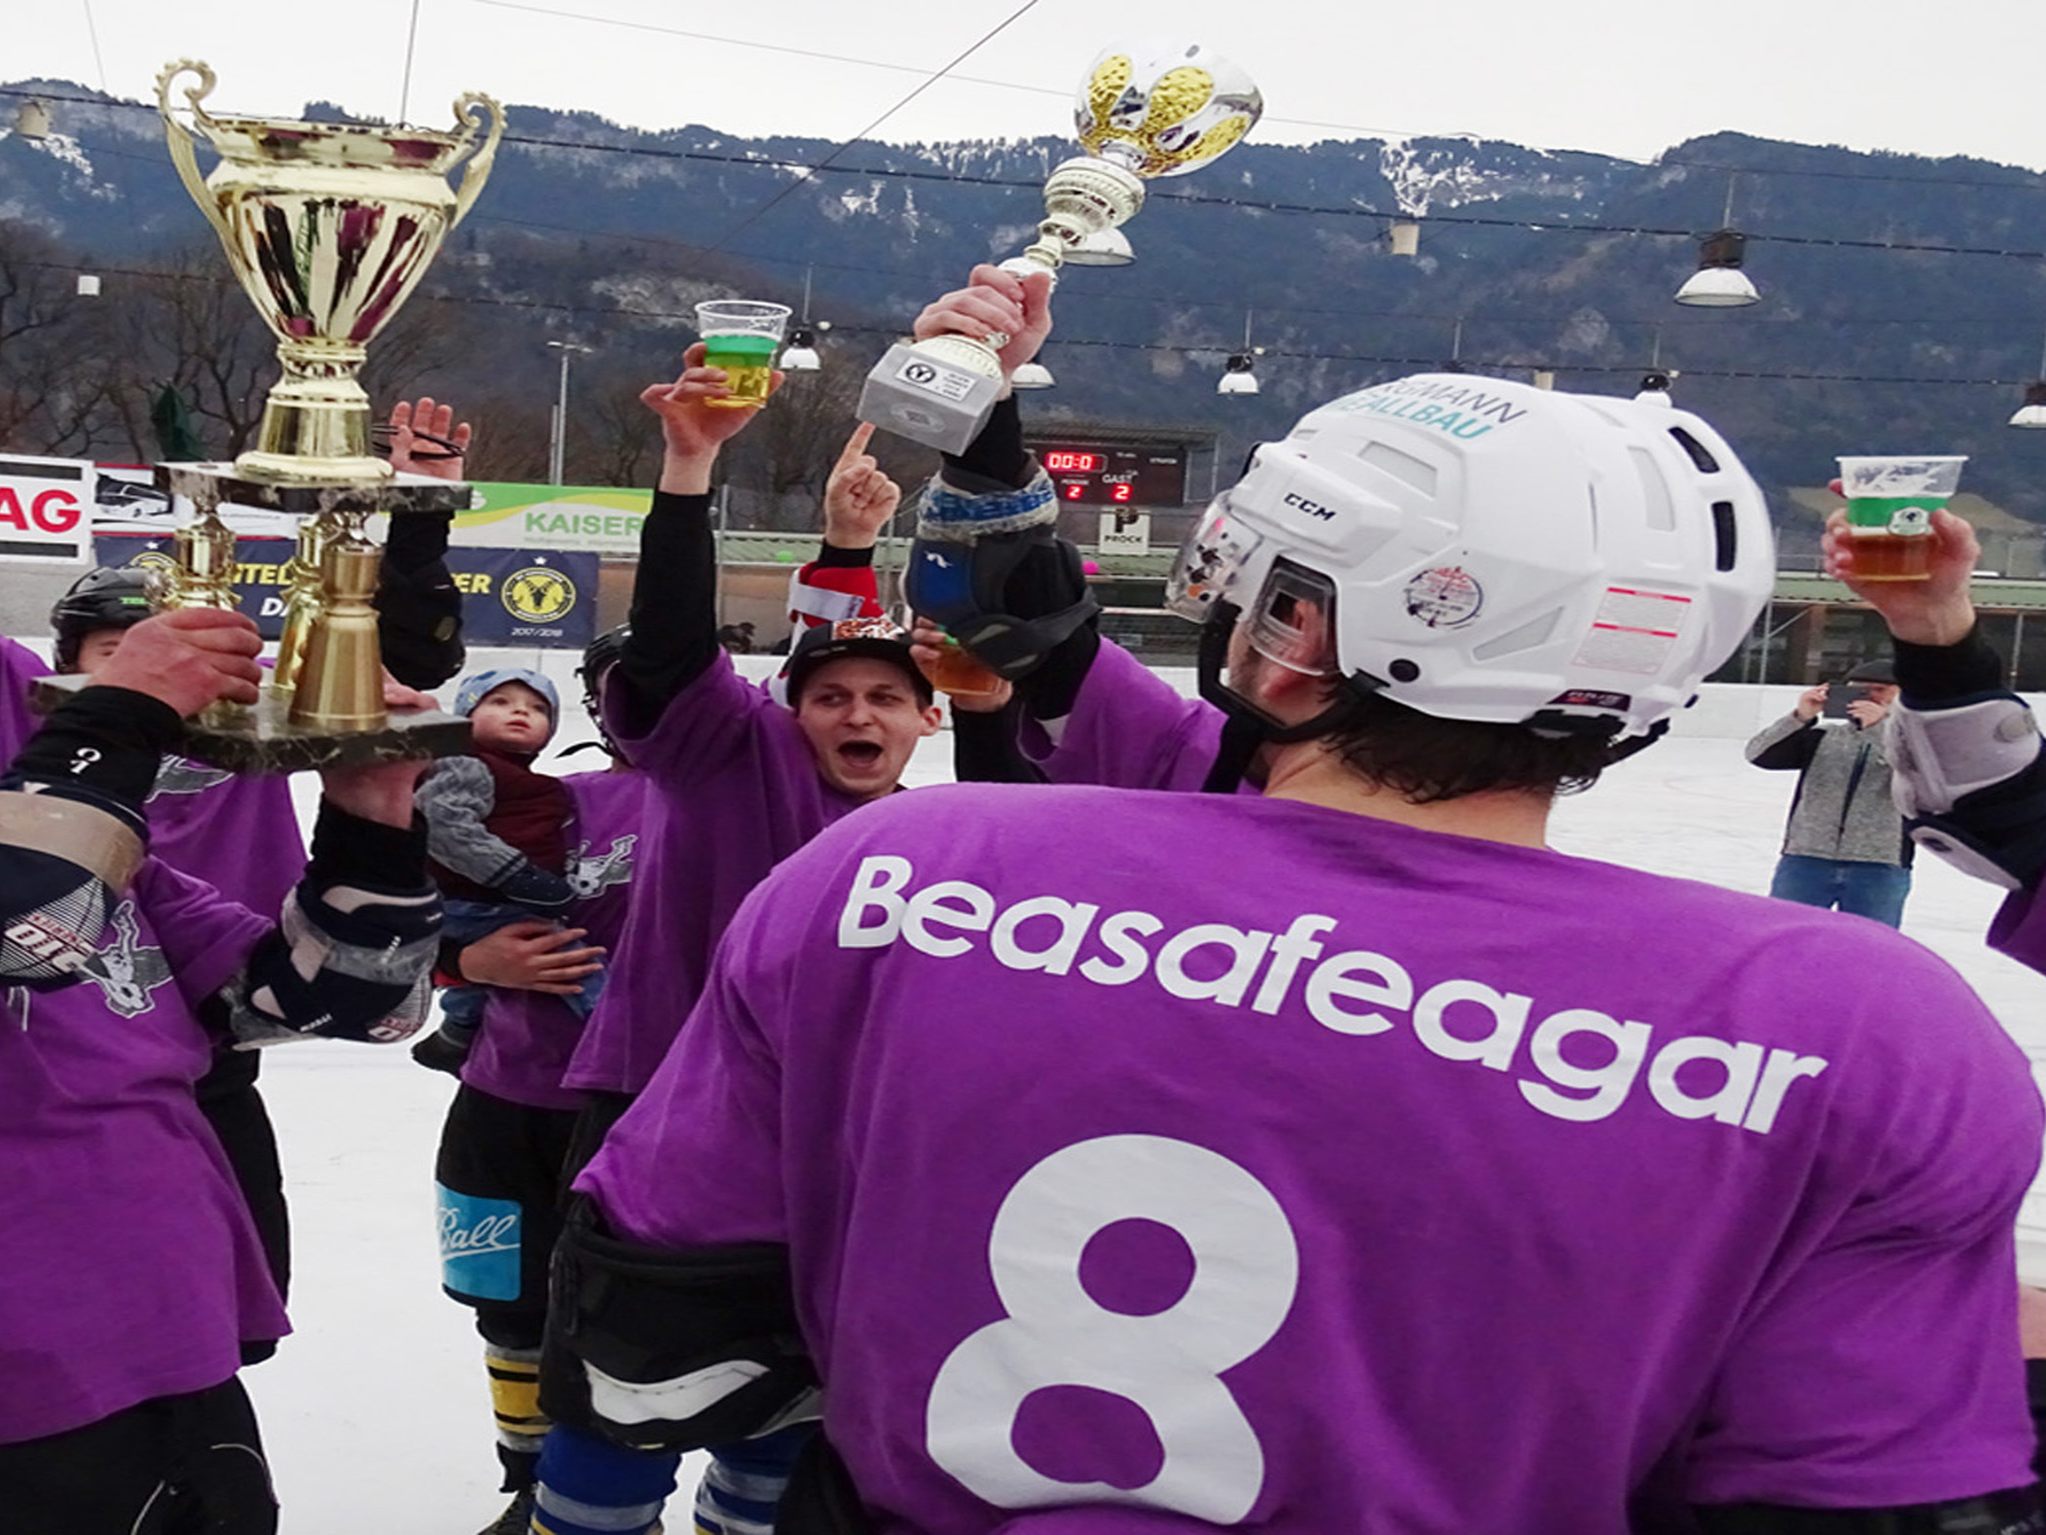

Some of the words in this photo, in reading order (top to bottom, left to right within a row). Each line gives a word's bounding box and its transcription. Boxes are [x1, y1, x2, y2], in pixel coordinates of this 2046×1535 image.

[1067, 486, 1081, 499] 2
[1114, 485, 1131, 500] 2
[1284, 492, 1336, 521] CCM
[525, 512, 643, 536] KAISER
[1104, 534, 1142, 543] PROCK
[452, 573, 492, 594] ER
[838, 855, 1828, 1134] Beasafeagar
[926, 1133, 1299, 1526] 8
